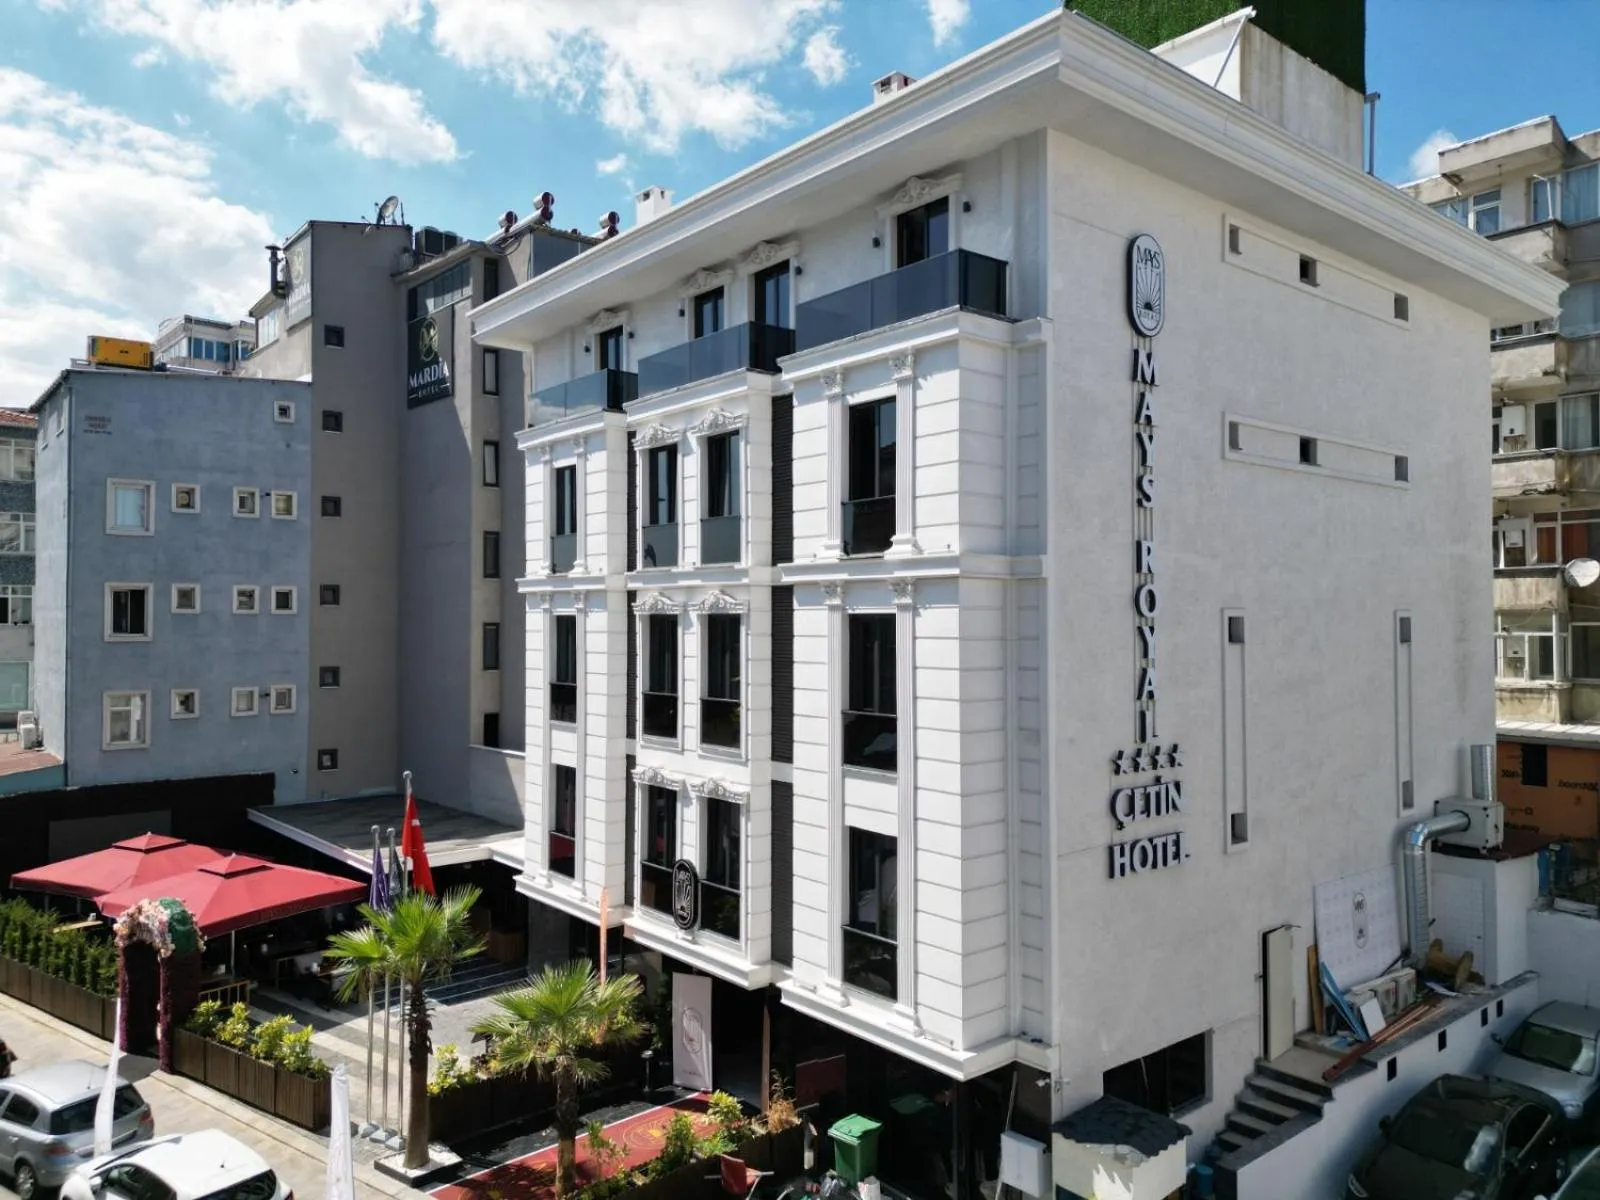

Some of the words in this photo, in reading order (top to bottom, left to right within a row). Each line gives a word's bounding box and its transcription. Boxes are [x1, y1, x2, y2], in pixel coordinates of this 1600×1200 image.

[1132, 349, 1159, 508] MAYS
[1134, 540, 1161, 743] ROYAL
[1108, 831, 1190, 879] HOTEL
[1111, 776, 1184, 830] ÇETİN
